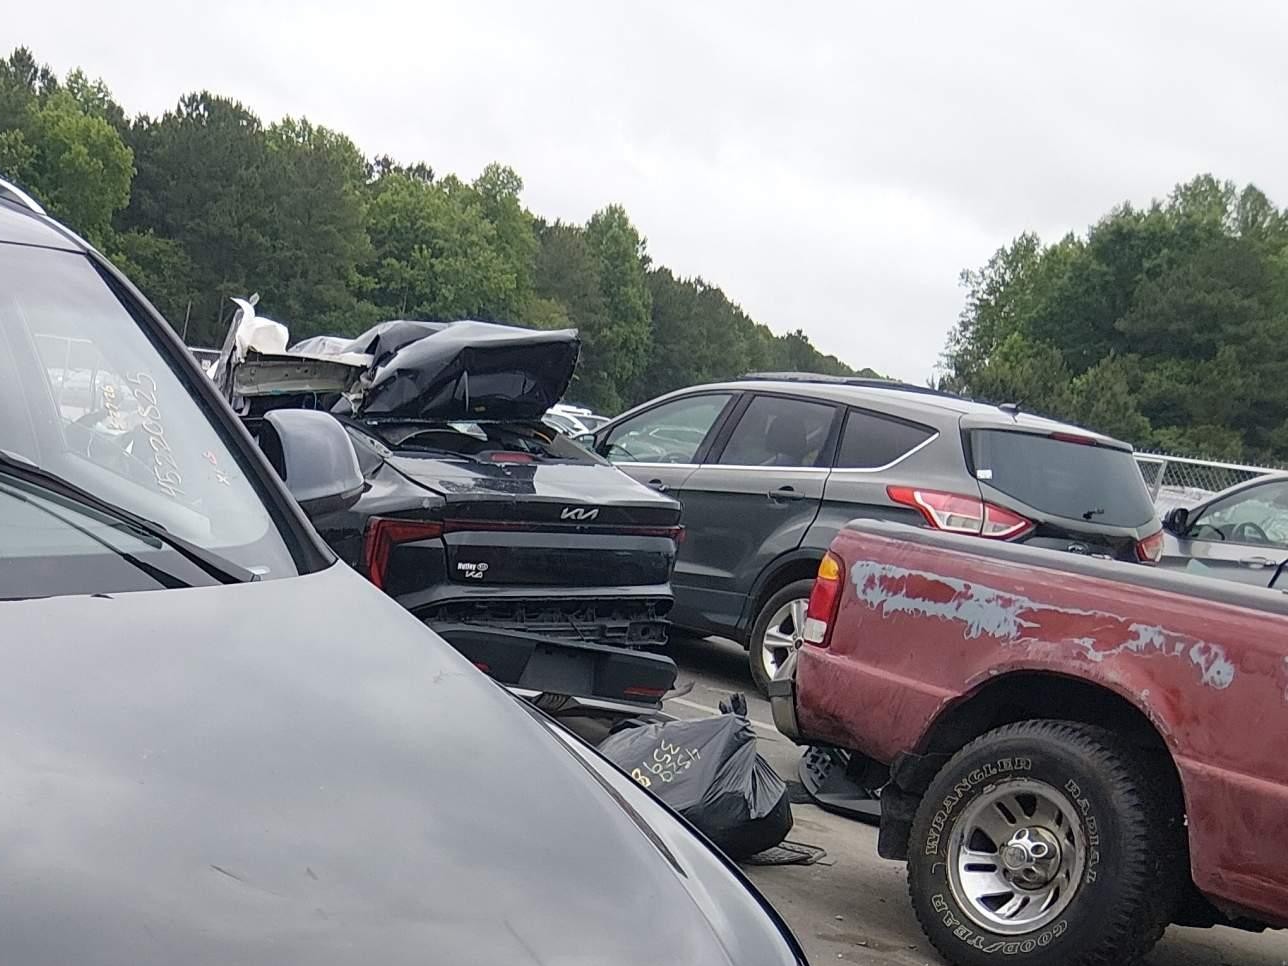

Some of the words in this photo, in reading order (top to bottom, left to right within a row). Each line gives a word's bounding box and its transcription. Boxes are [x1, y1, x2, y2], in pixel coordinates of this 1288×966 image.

[126, 371, 185, 497] 45220825
[926, 757, 1032, 855] WRANGLER
[1064, 779, 1101, 884] RADIAL
